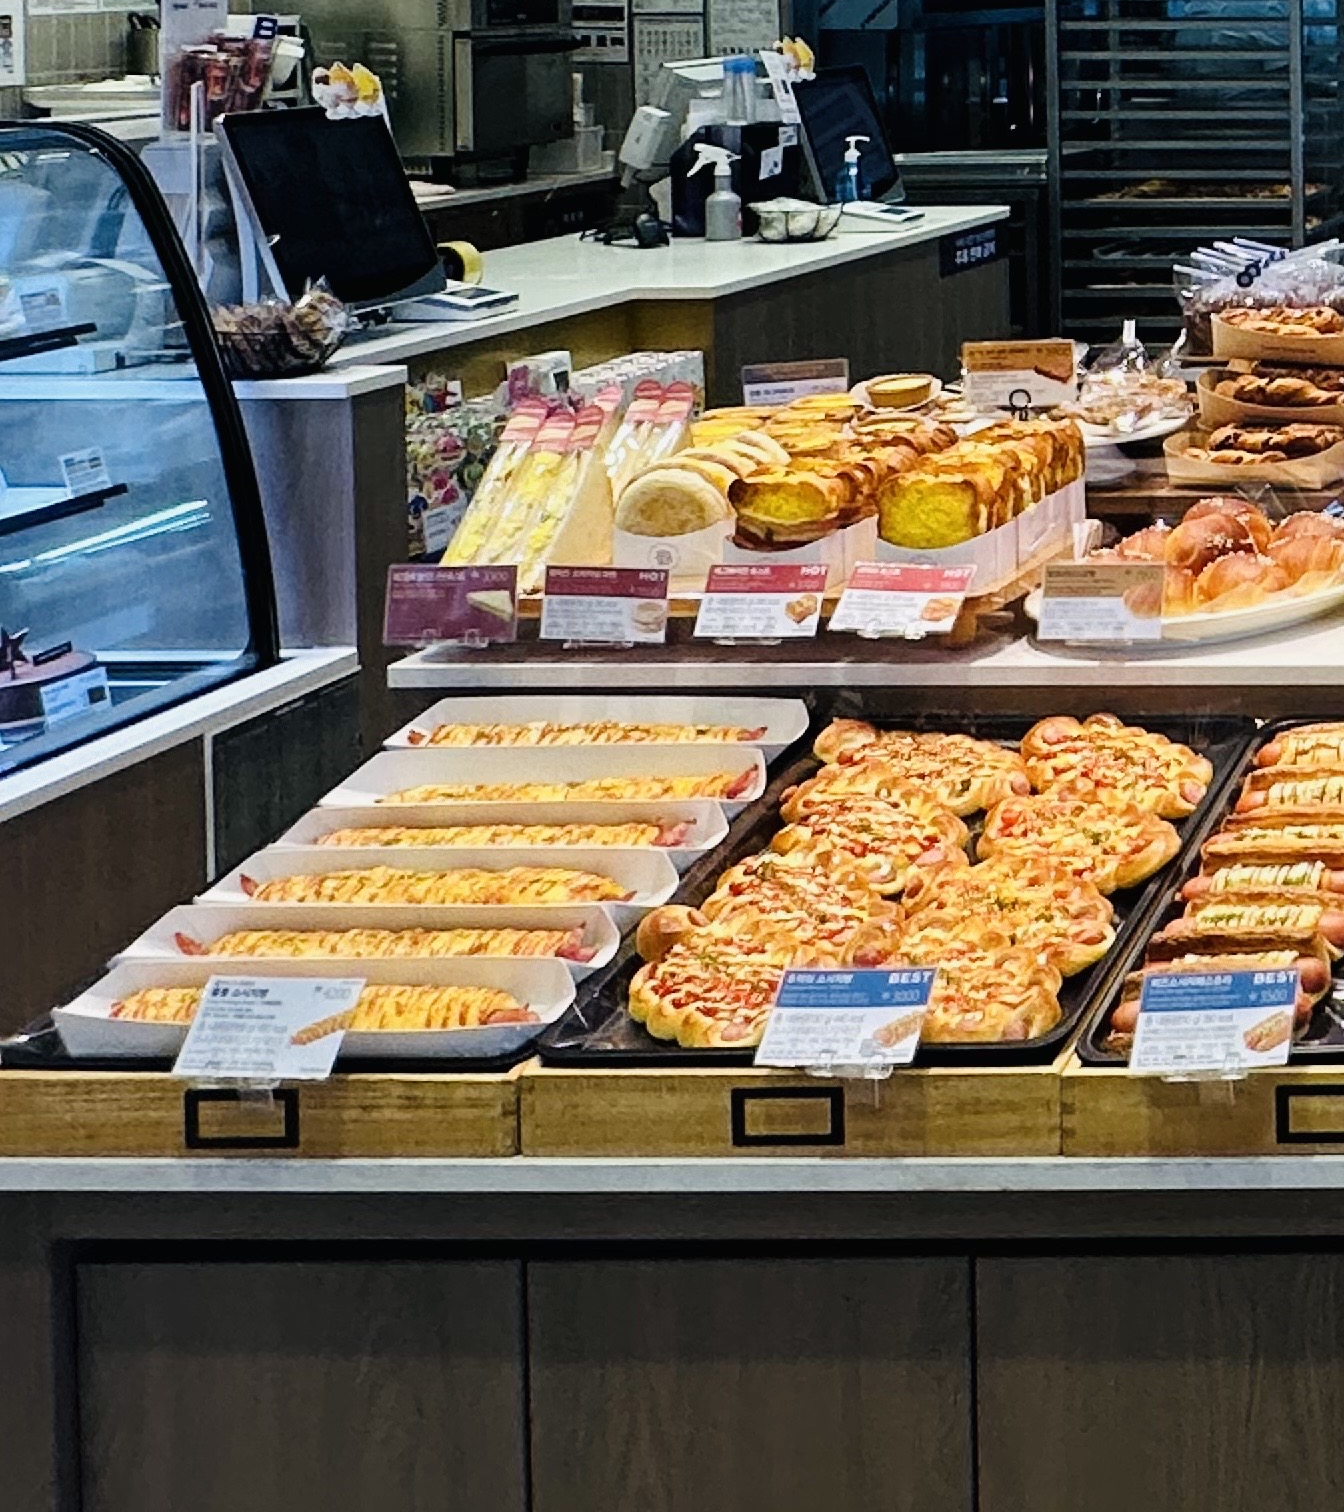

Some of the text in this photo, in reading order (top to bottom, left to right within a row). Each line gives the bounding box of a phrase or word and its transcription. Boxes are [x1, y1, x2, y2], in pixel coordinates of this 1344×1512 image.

[639, 571, 666, 582] HOT
[801, 566, 827, 576] HOT
[888, 972, 933, 984] BEST
[1253, 970, 1297, 985] BEST
